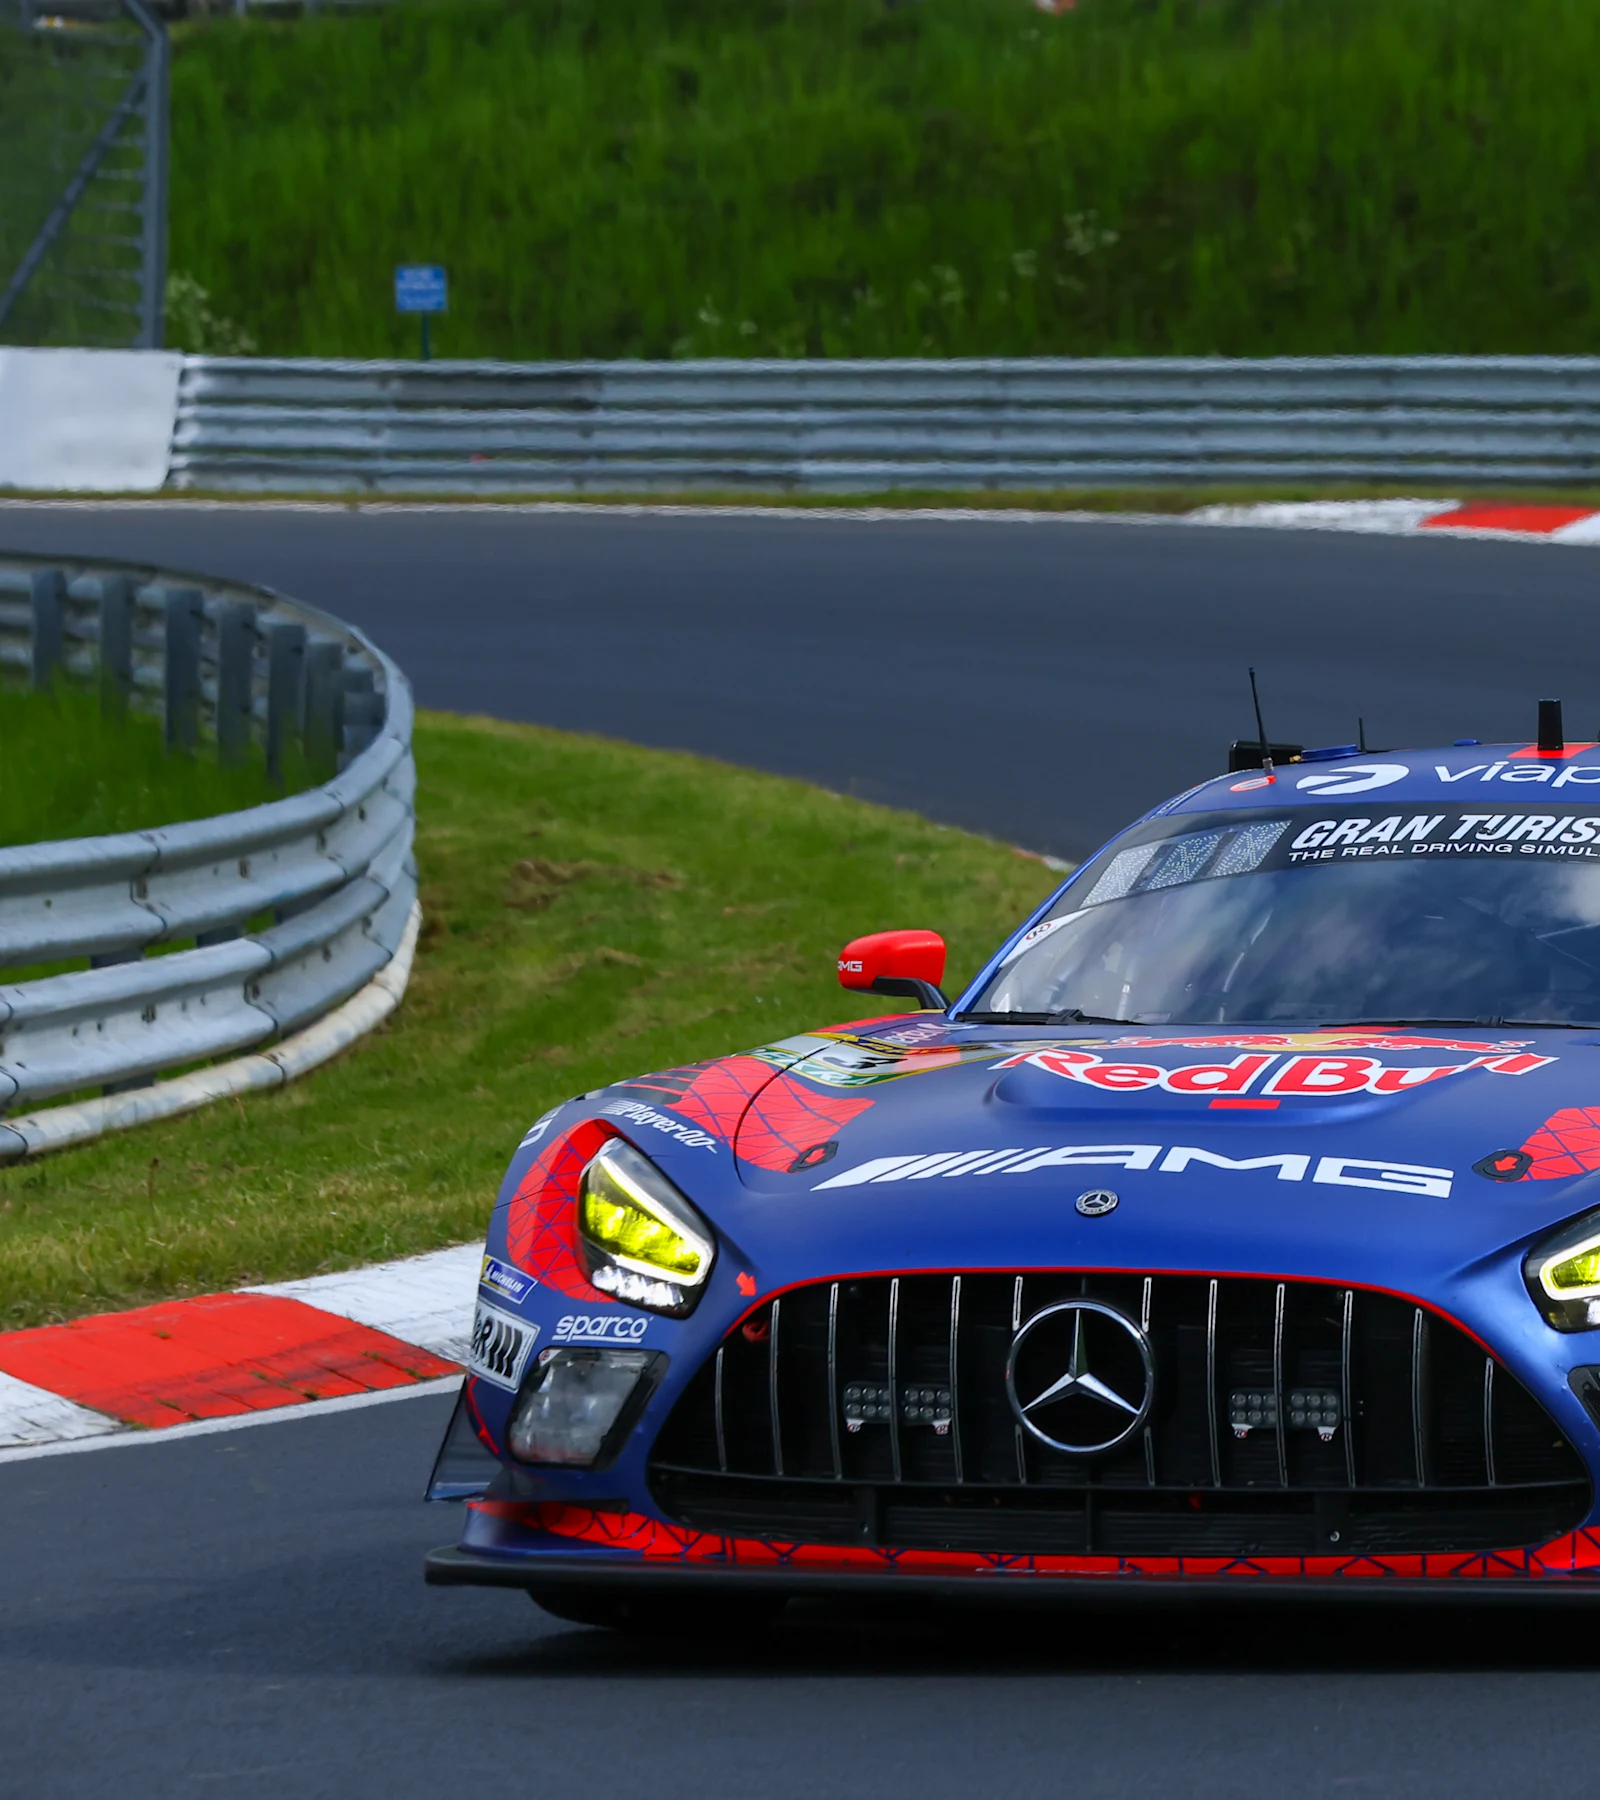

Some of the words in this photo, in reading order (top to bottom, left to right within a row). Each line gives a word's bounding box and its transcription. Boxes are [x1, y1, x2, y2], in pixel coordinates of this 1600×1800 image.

[1290, 815, 1446, 851] GRAN
[1289, 850, 1334, 862] THE
[1341, 844, 1404, 857] REAL
[1412, 842, 1510, 855] DRIVING
[987, 1048, 1280, 1094] Red
[1260, 1054, 1560, 1095] Bull
[1002, 1145, 1454, 1199] AMG
[491, 1269, 525, 1294] MICHELIN
[556, 1315, 648, 1343] sparco
